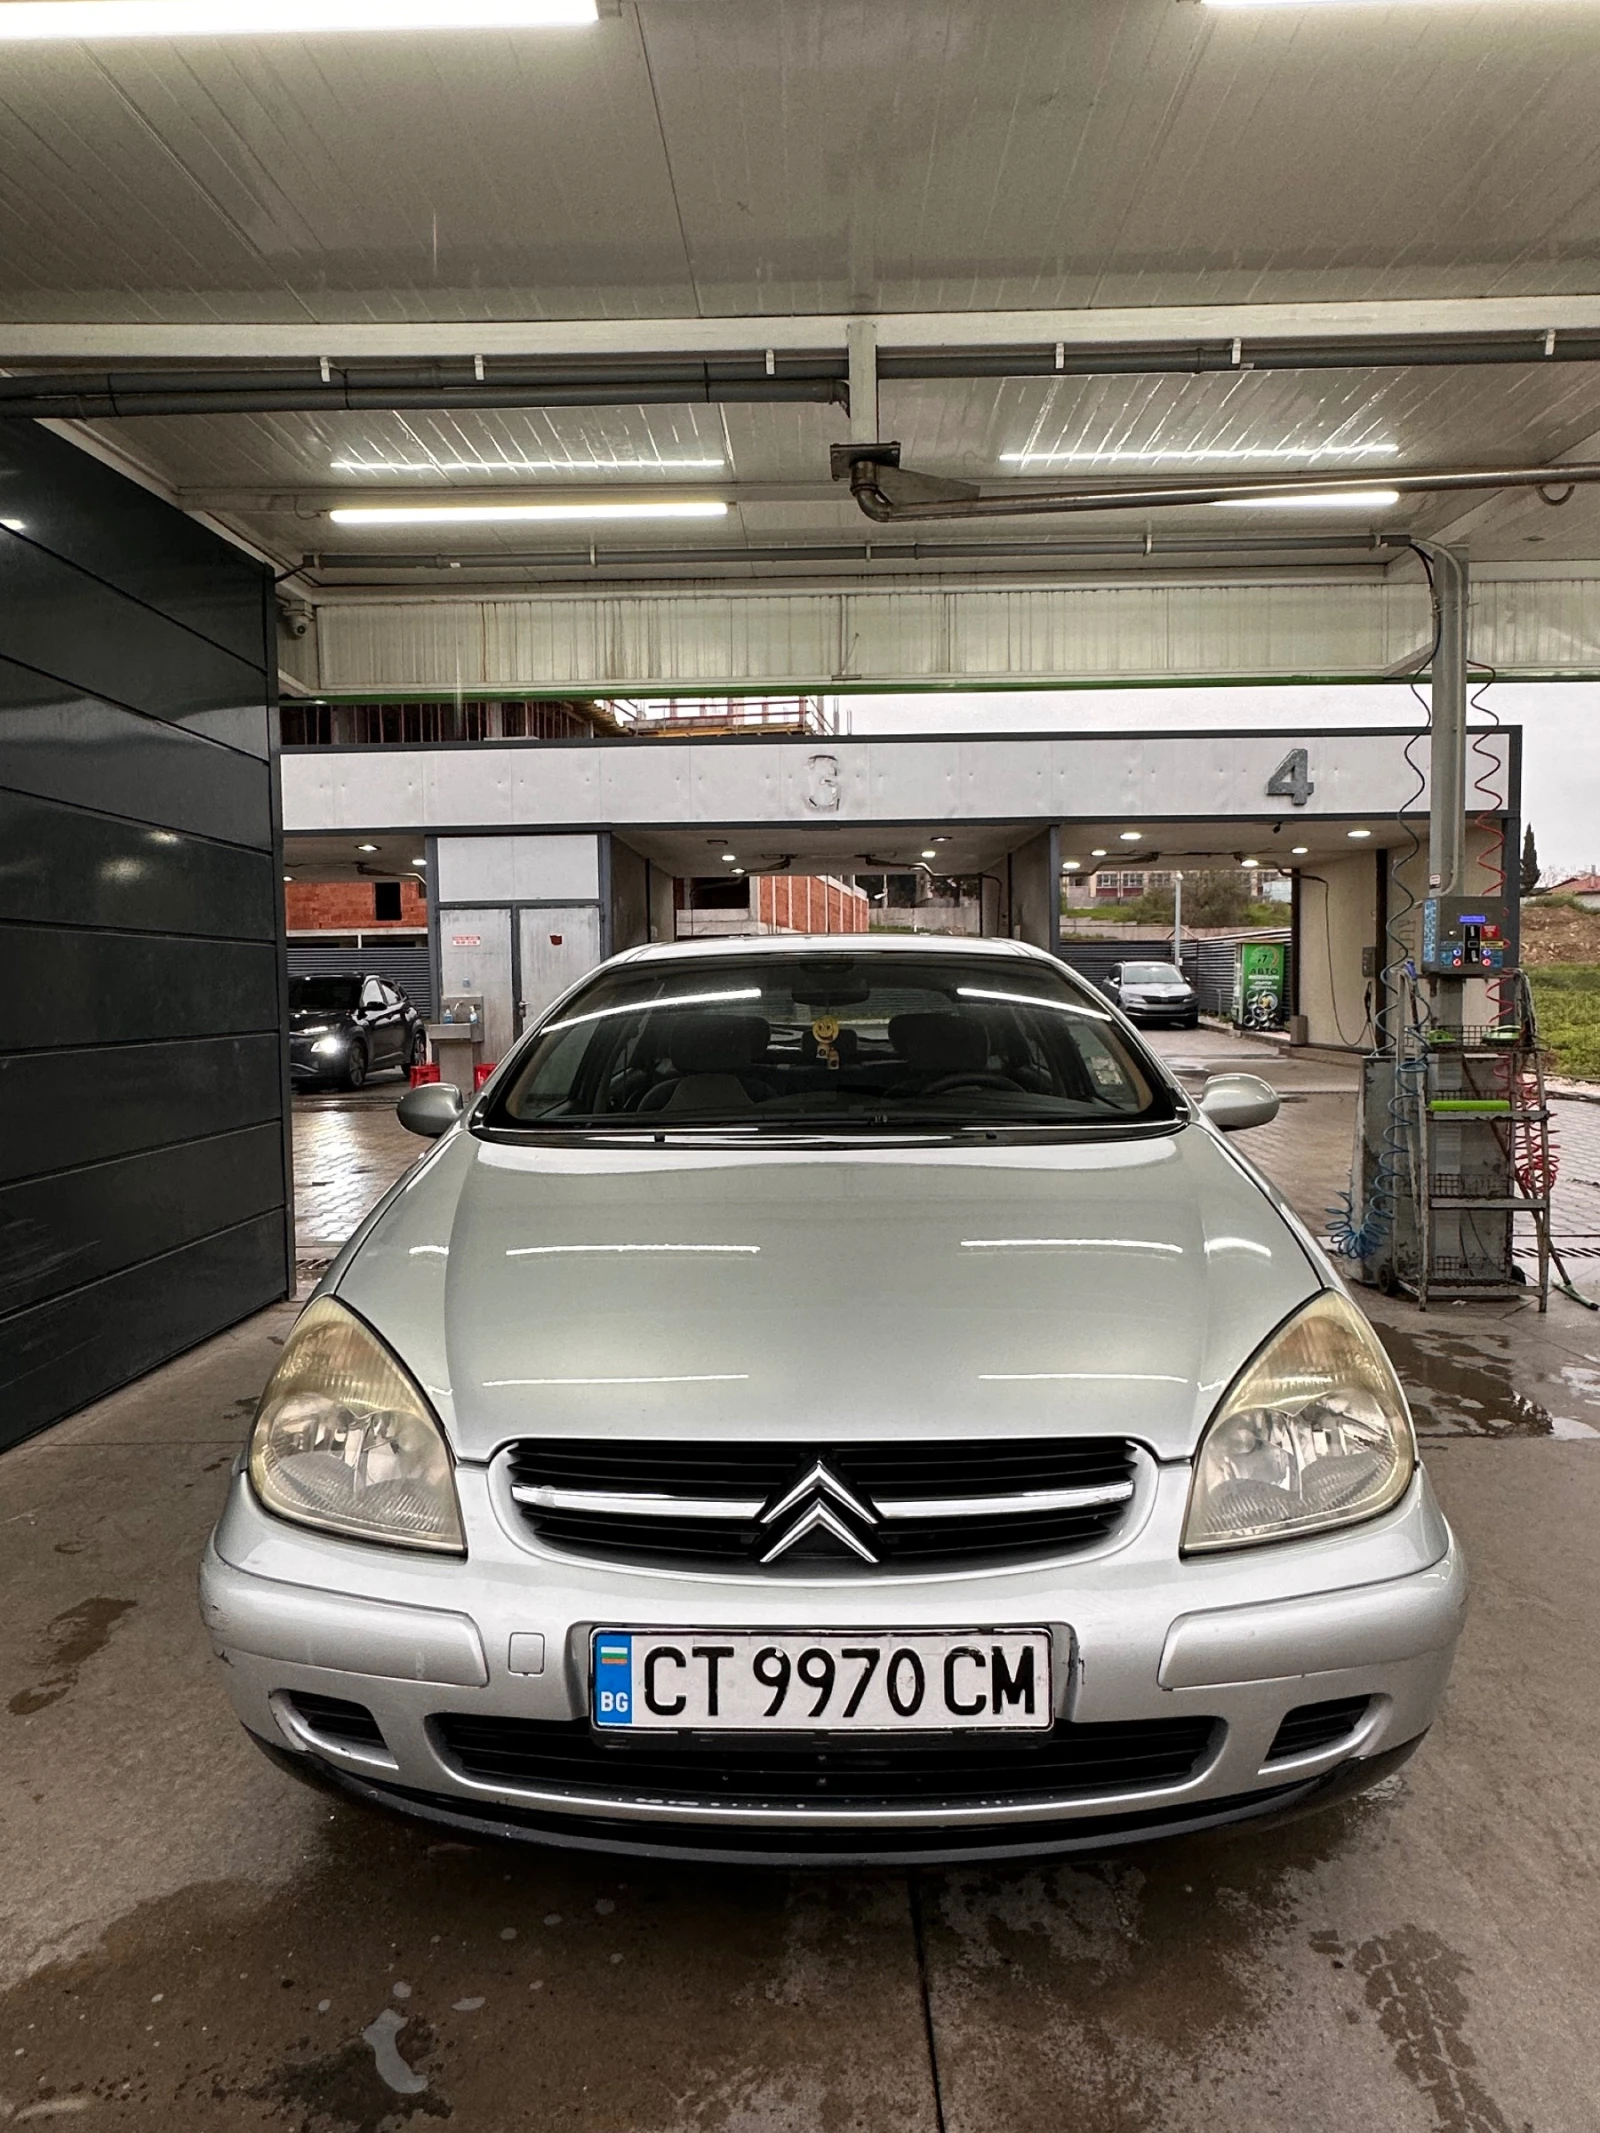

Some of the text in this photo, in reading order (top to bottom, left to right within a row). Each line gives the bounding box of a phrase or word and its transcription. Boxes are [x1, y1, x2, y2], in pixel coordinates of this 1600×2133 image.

[1265, 748, 1314, 806] 4
[600, 1691, 629, 1713] BG
[644, 1645, 1035, 1717] CT 9970 CM
